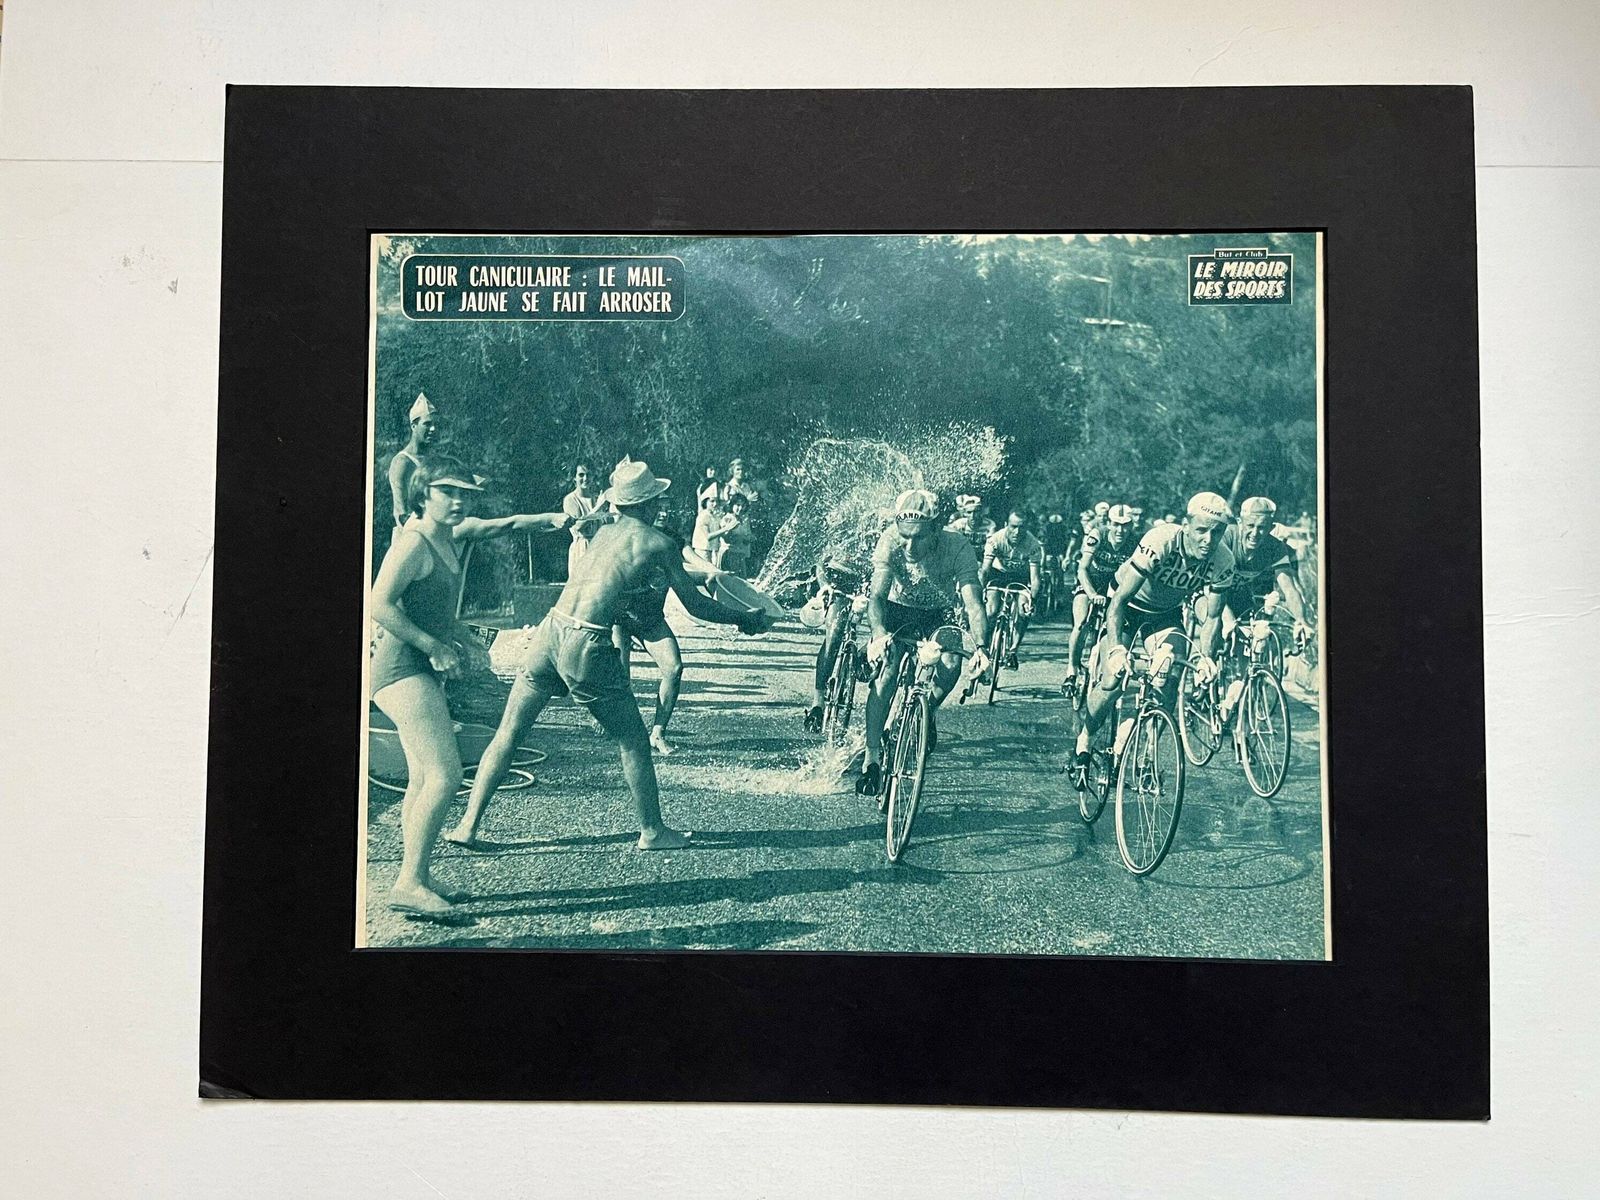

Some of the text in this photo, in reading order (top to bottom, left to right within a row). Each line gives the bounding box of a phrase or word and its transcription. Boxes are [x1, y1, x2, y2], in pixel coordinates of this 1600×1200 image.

[415, 265, 458, 287] TOUR
[469, 266, 572, 288] CANICULAIRE
[598, 266, 616, 287] LE
[627, 266, 673, 287] MAIL-
[1194, 261, 1289, 280] LE MIROIR
[1193, 281, 1287, 299] DES SPORTS
[416, 291, 672, 313] LOT JAUNE SE FAIT ARROSER
